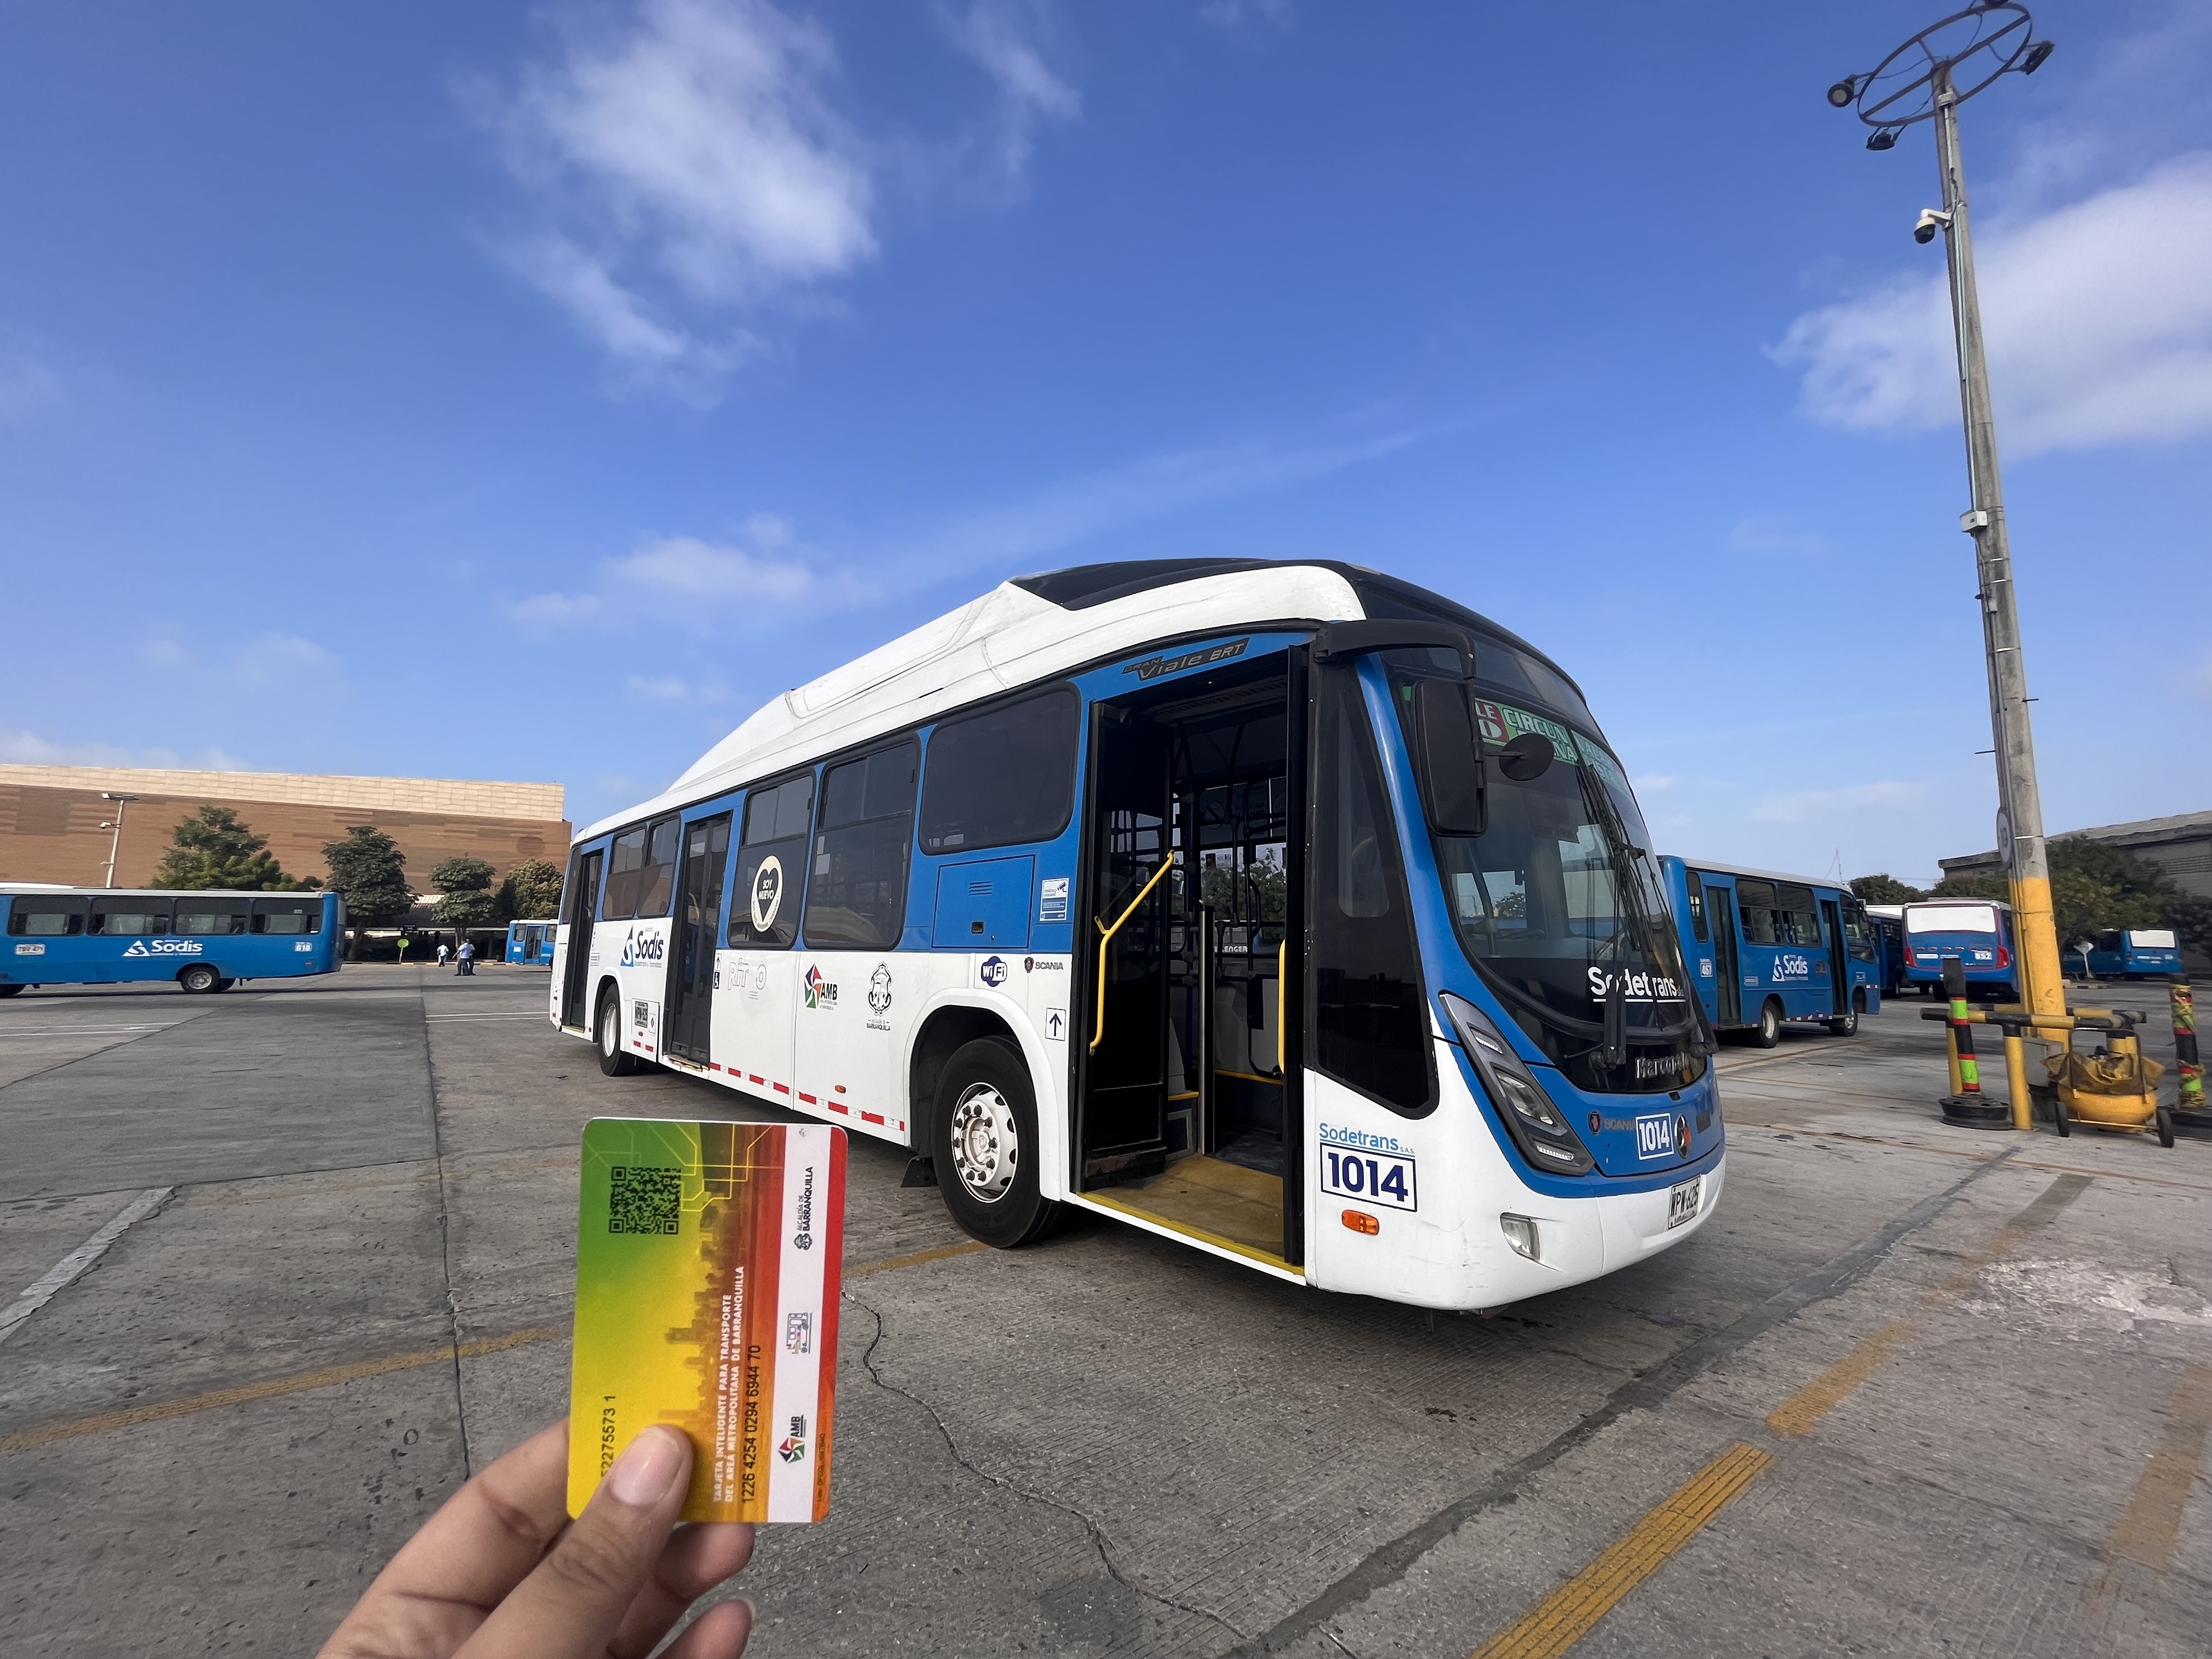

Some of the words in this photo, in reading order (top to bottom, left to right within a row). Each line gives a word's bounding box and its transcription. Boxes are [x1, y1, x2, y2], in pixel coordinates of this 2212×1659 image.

[1139, 655, 1203, 678] Viale
[1210, 643, 1245, 661] BRT
[1503, 708, 1568, 743] CIRCUN
[758, 890, 774, 900] NUEVO
[763, 879, 772, 889] SOY
[151, 940, 203, 952] Sodis
[635, 930, 664, 960] Sodis
[1035, 962, 1063, 970] SCANIA
[1784, 955, 1808, 974] Sodis
[821, 983, 837, 1000] AMB
[1319, 1123, 1399, 1151] Sodetrans
[1639, 1120, 1669, 1152] 1014
[1328, 1152, 1408, 1202] 1014
[803, 1167, 813, 1231] BARRANQUILLA
[732, 1266, 744, 1345] BARRANQUILLA
[720, 1295, 732, 1361] TRANSPORTE
[731, 1347, 740, 1361] DE
[748, 1345, 761, 1361] 70
[719, 1364, 728, 1390] PARA
[746, 1366, 759, 1397] 6944
[727, 1366, 739, 1451] METROPOLITANA
[744, 1402, 758, 1432] 0294
[716, 1395, 726, 1458] INTELIGENTE
[790, 1416, 800, 1437] AMB
[743, 1438, 757, 1469] 4254
[714, 1461, 724, 1502] TARJETA
[725, 1483, 733, 1502] DEL
[742, 1473, 755, 1503] 1226
